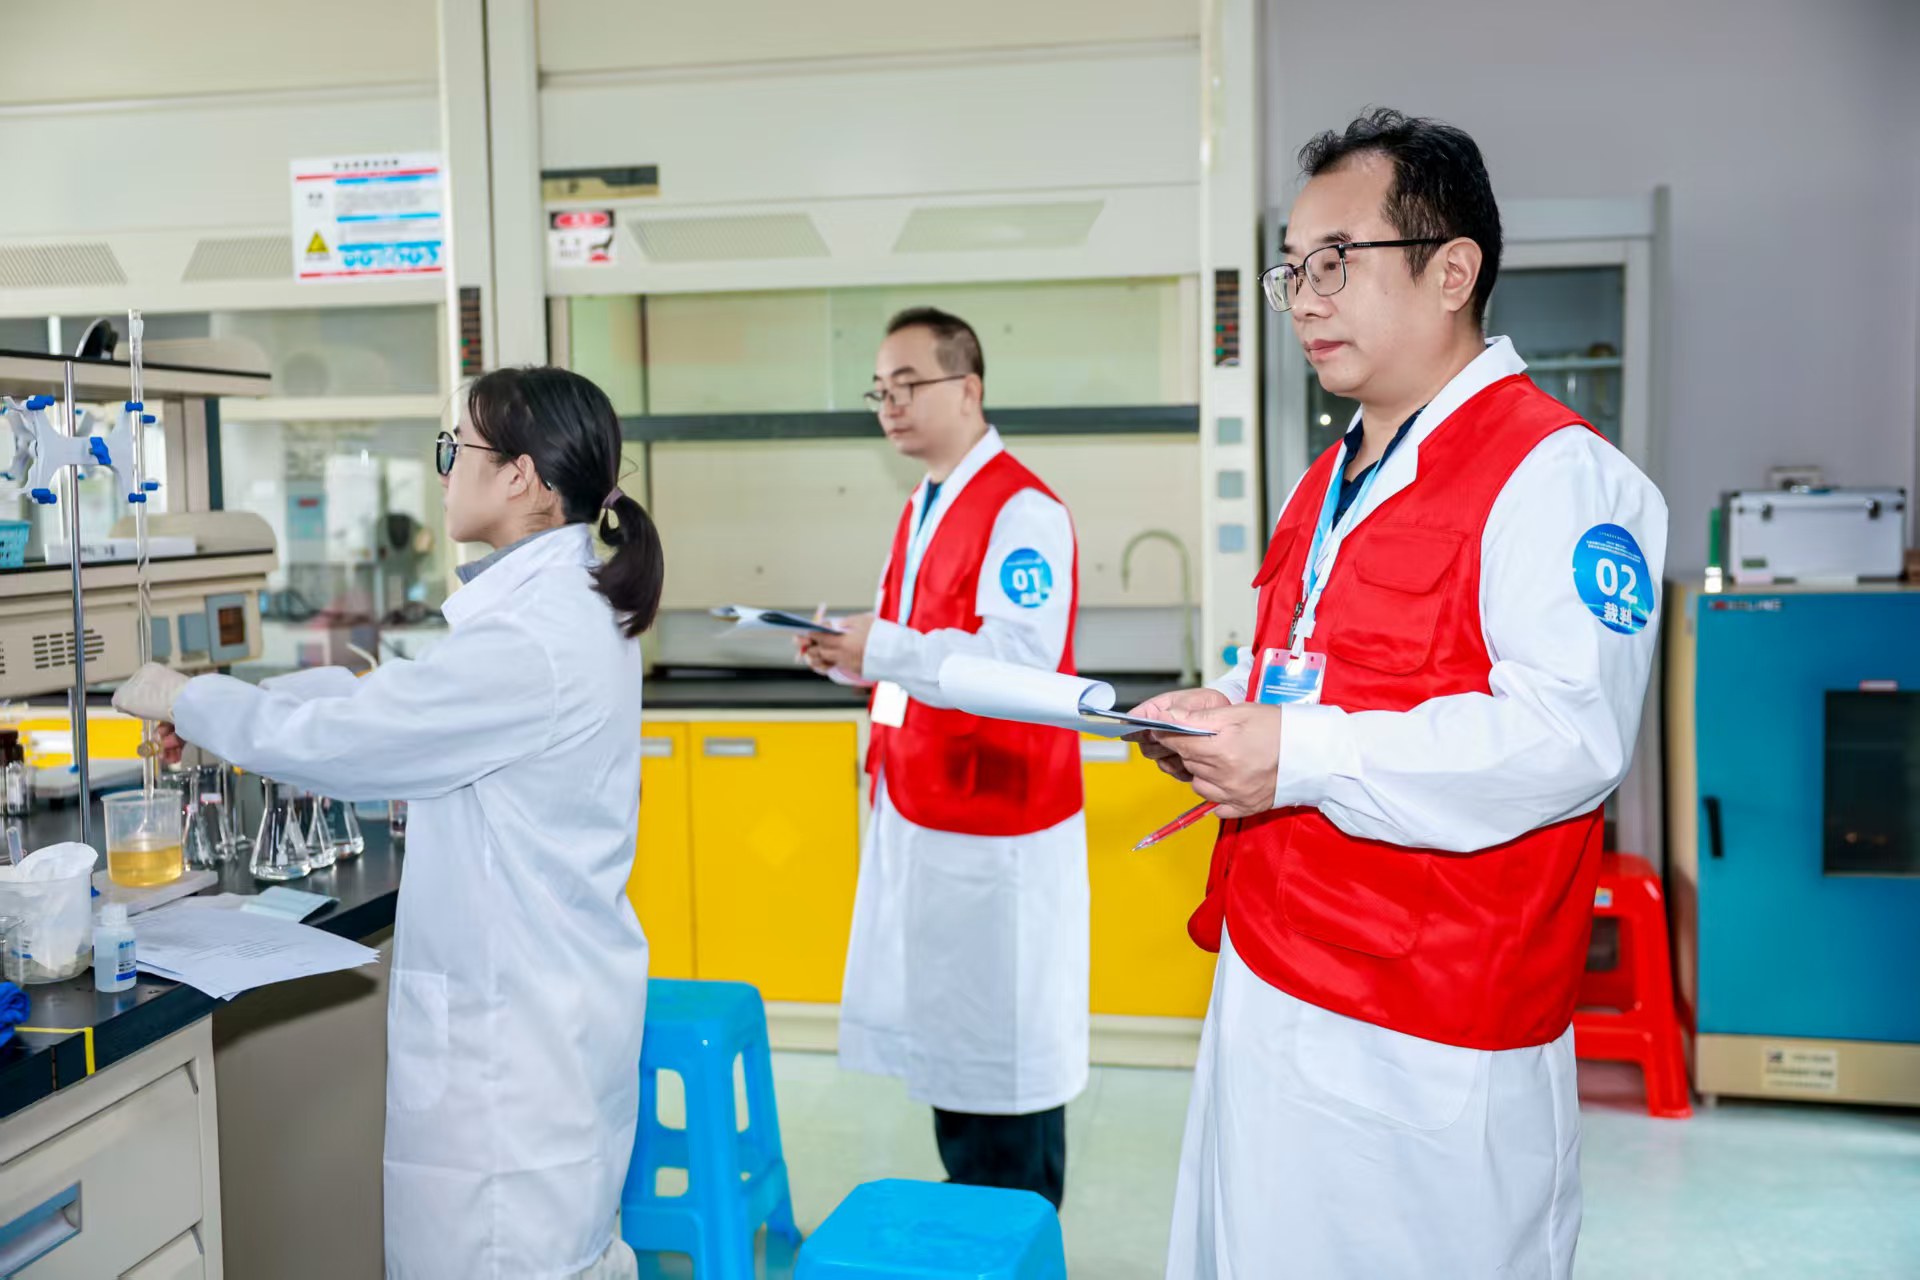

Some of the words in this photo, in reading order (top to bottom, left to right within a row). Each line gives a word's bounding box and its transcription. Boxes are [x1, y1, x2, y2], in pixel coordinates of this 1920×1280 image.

[1012, 567, 1040, 592] 01
[1595, 557, 1638, 604] 02
[1603, 601, 1633, 628] 裁判
